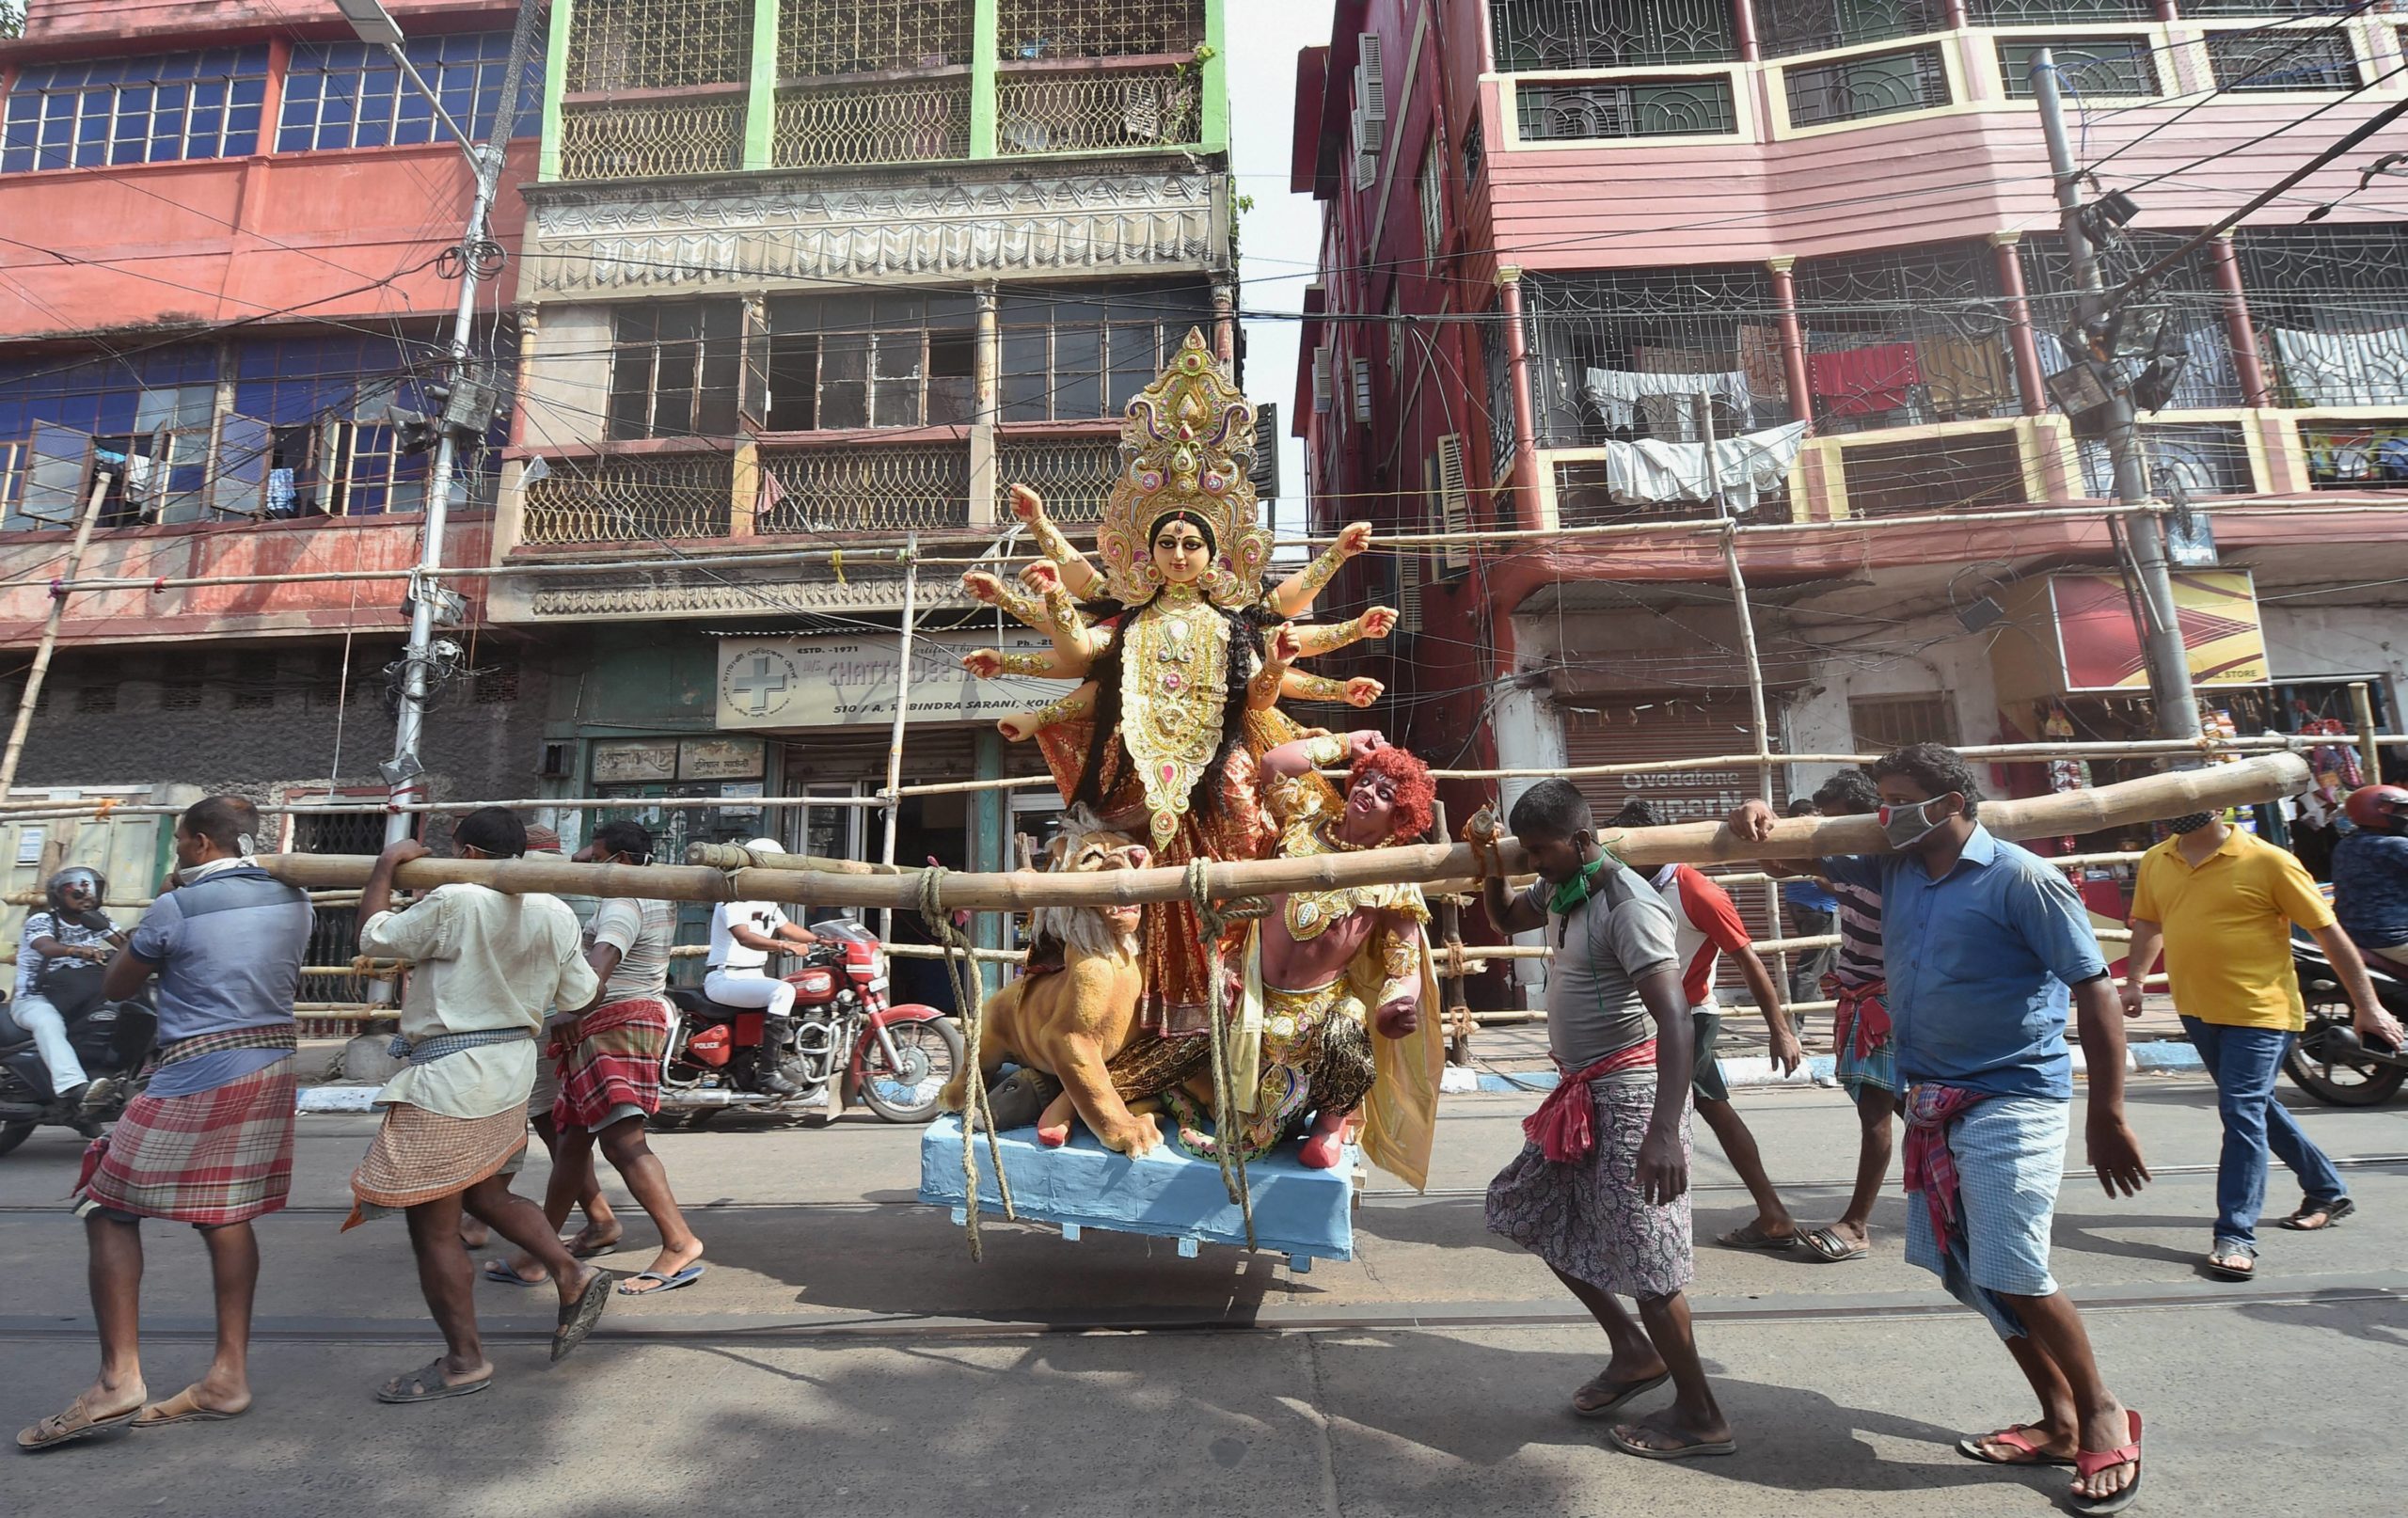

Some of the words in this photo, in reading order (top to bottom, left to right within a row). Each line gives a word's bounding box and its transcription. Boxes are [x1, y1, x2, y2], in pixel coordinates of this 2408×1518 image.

[911, 642, 956, 656] ertified
[2225, 669, 2258, 678] STORE
[833, 704, 857, 714] 510
[965, 699, 1020, 711] SARANI,
